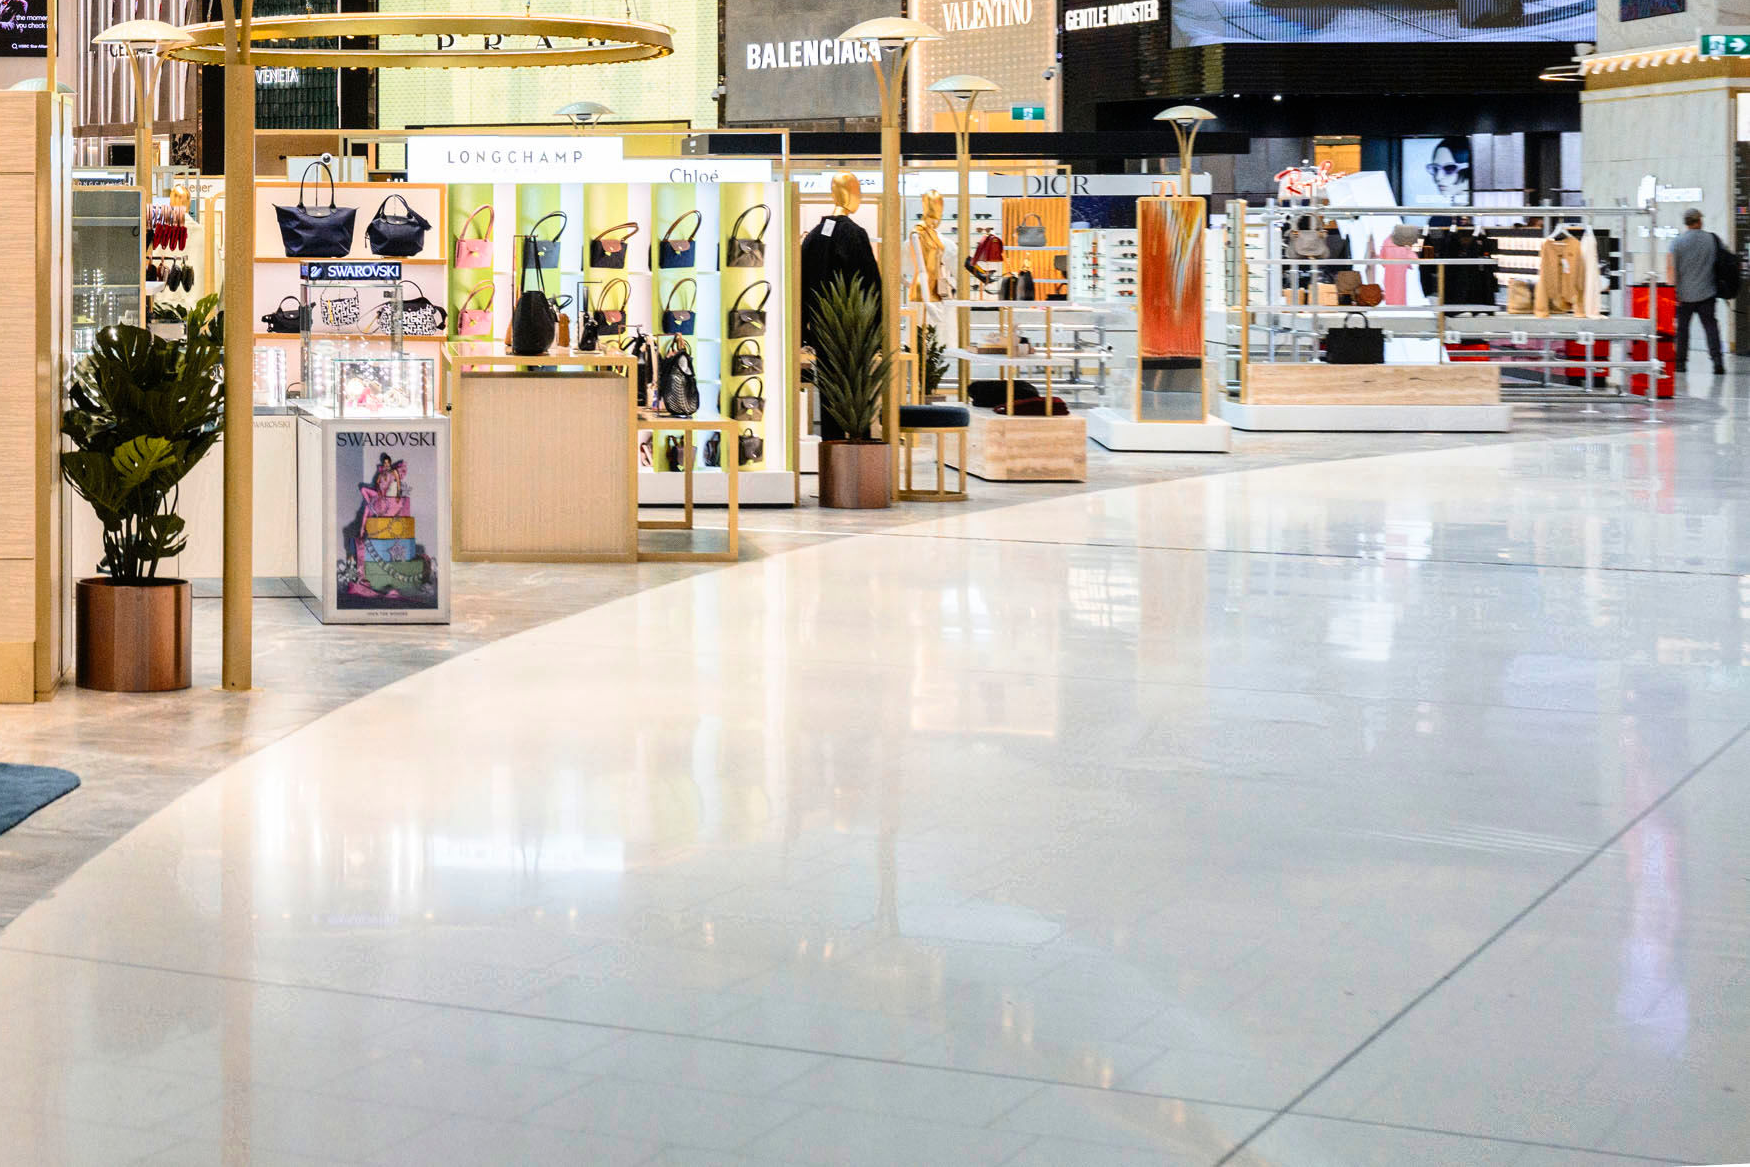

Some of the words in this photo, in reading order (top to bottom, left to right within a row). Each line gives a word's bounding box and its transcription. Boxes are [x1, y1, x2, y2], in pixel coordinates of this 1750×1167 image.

[1065, 6, 1107, 31] GENTLE
[1107, 0, 1159, 26] MONSTER
[746, 38, 883, 70] BALENCIAGA
[254, 68, 299, 84] VENETA
[447, 150, 583, 164] LONGCHAMP
[669, 168, 719, 184] Chloé
[327, 265, 400, 278] SWAROVSKI
[253, 420, 291, 429] WAROVSKI
[336, 432, 438, 447] SWAROVSKI
